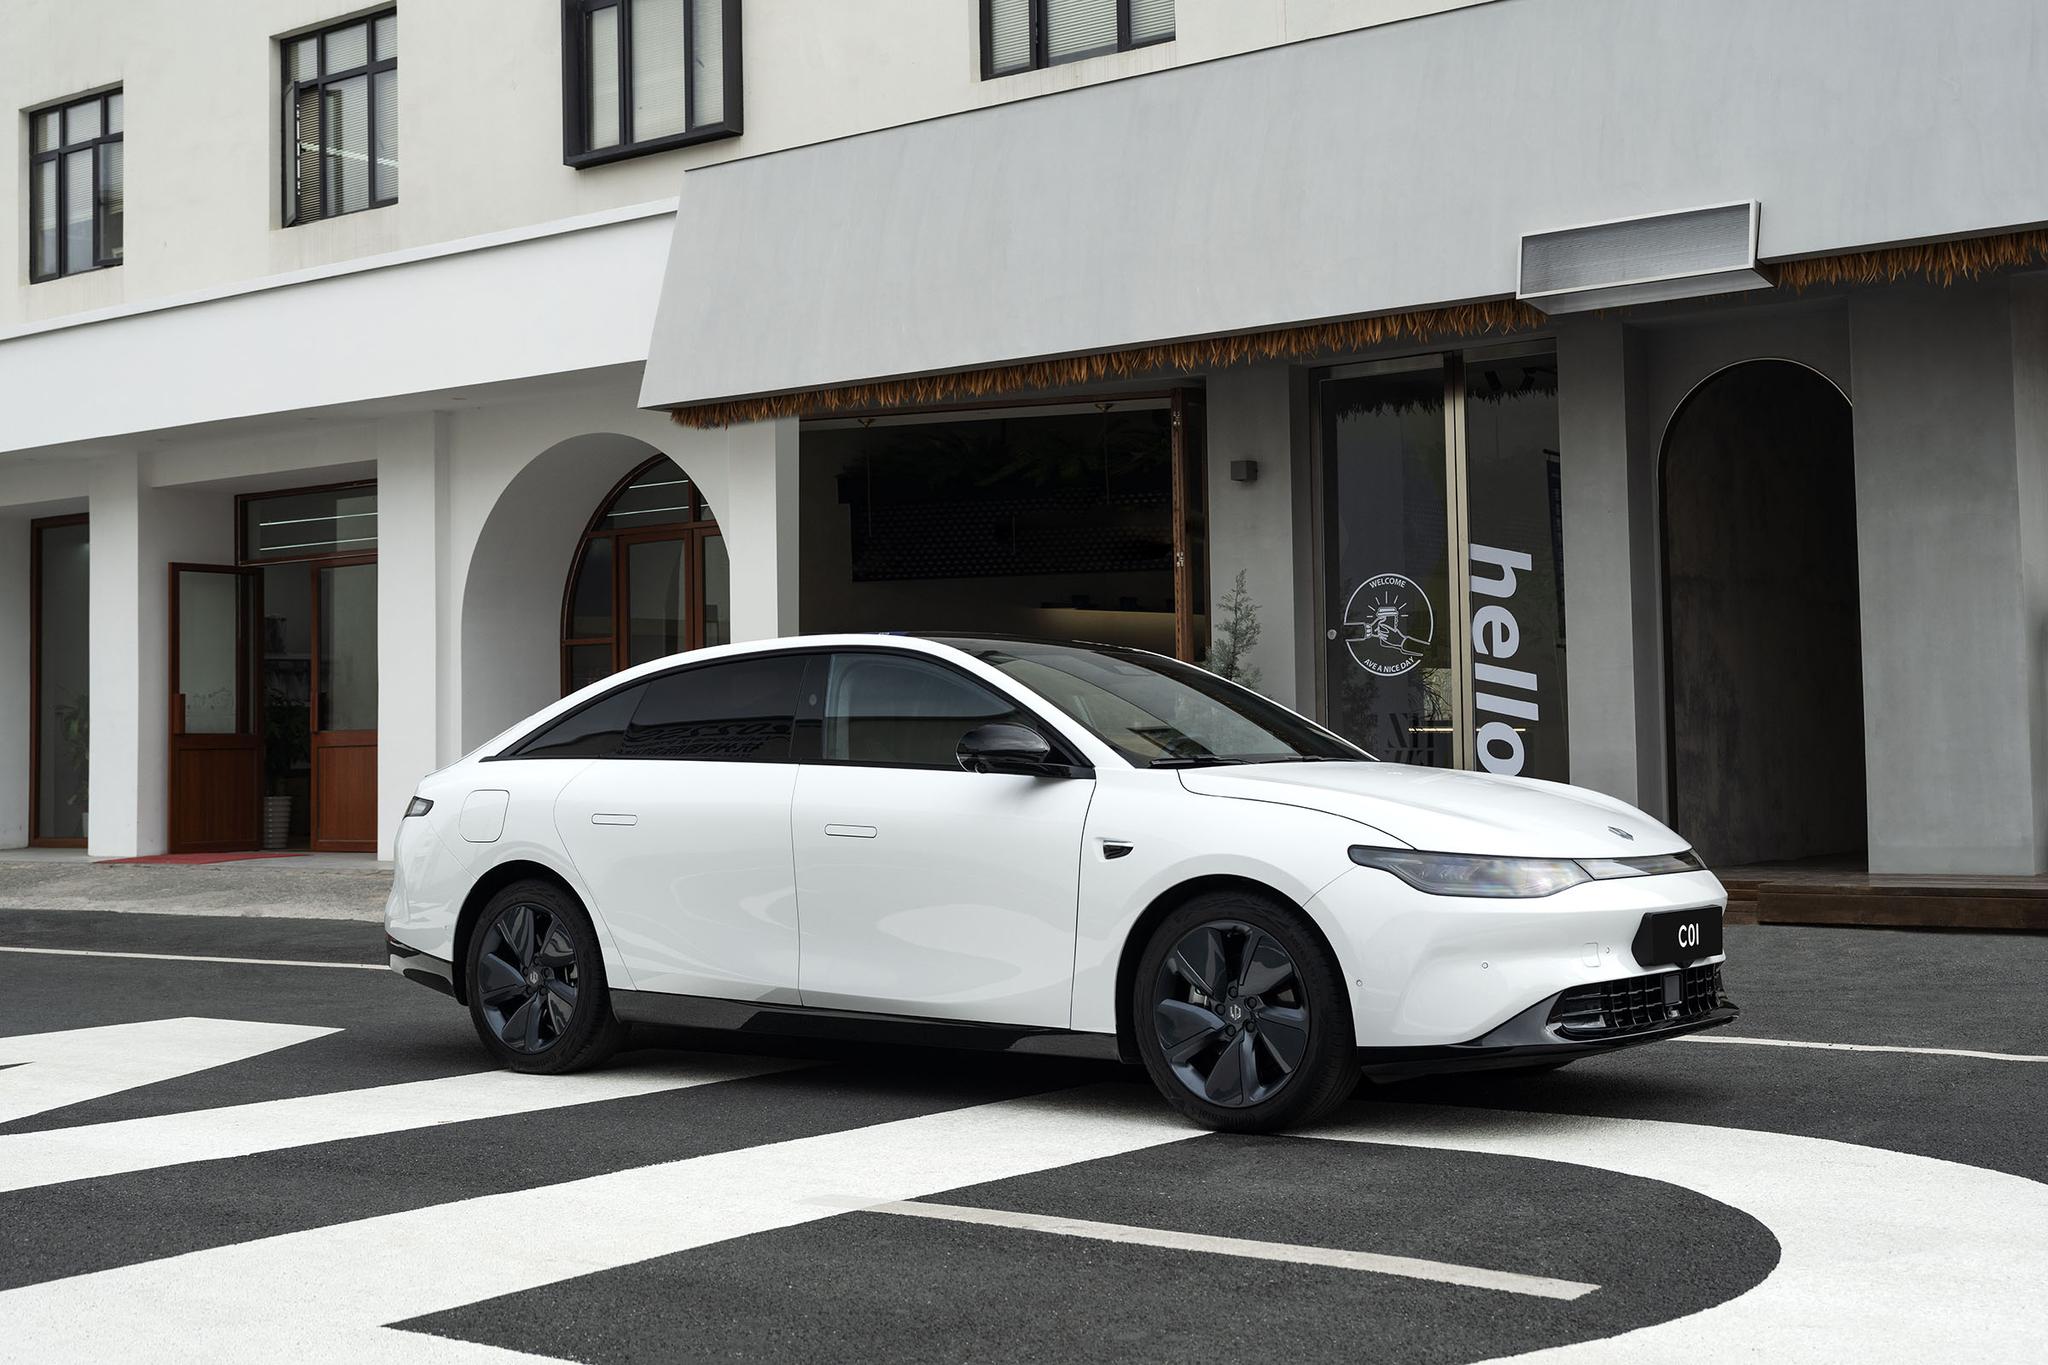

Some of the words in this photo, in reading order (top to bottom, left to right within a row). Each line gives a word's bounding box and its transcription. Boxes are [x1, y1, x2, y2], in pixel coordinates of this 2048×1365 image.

[1369, 577, 1406, 588] WELCOME
[1383, 664, 1401, 673] NICE
[1400, 656, 1415, 669] DAY
[1470, 543, 1539, 776] hello
